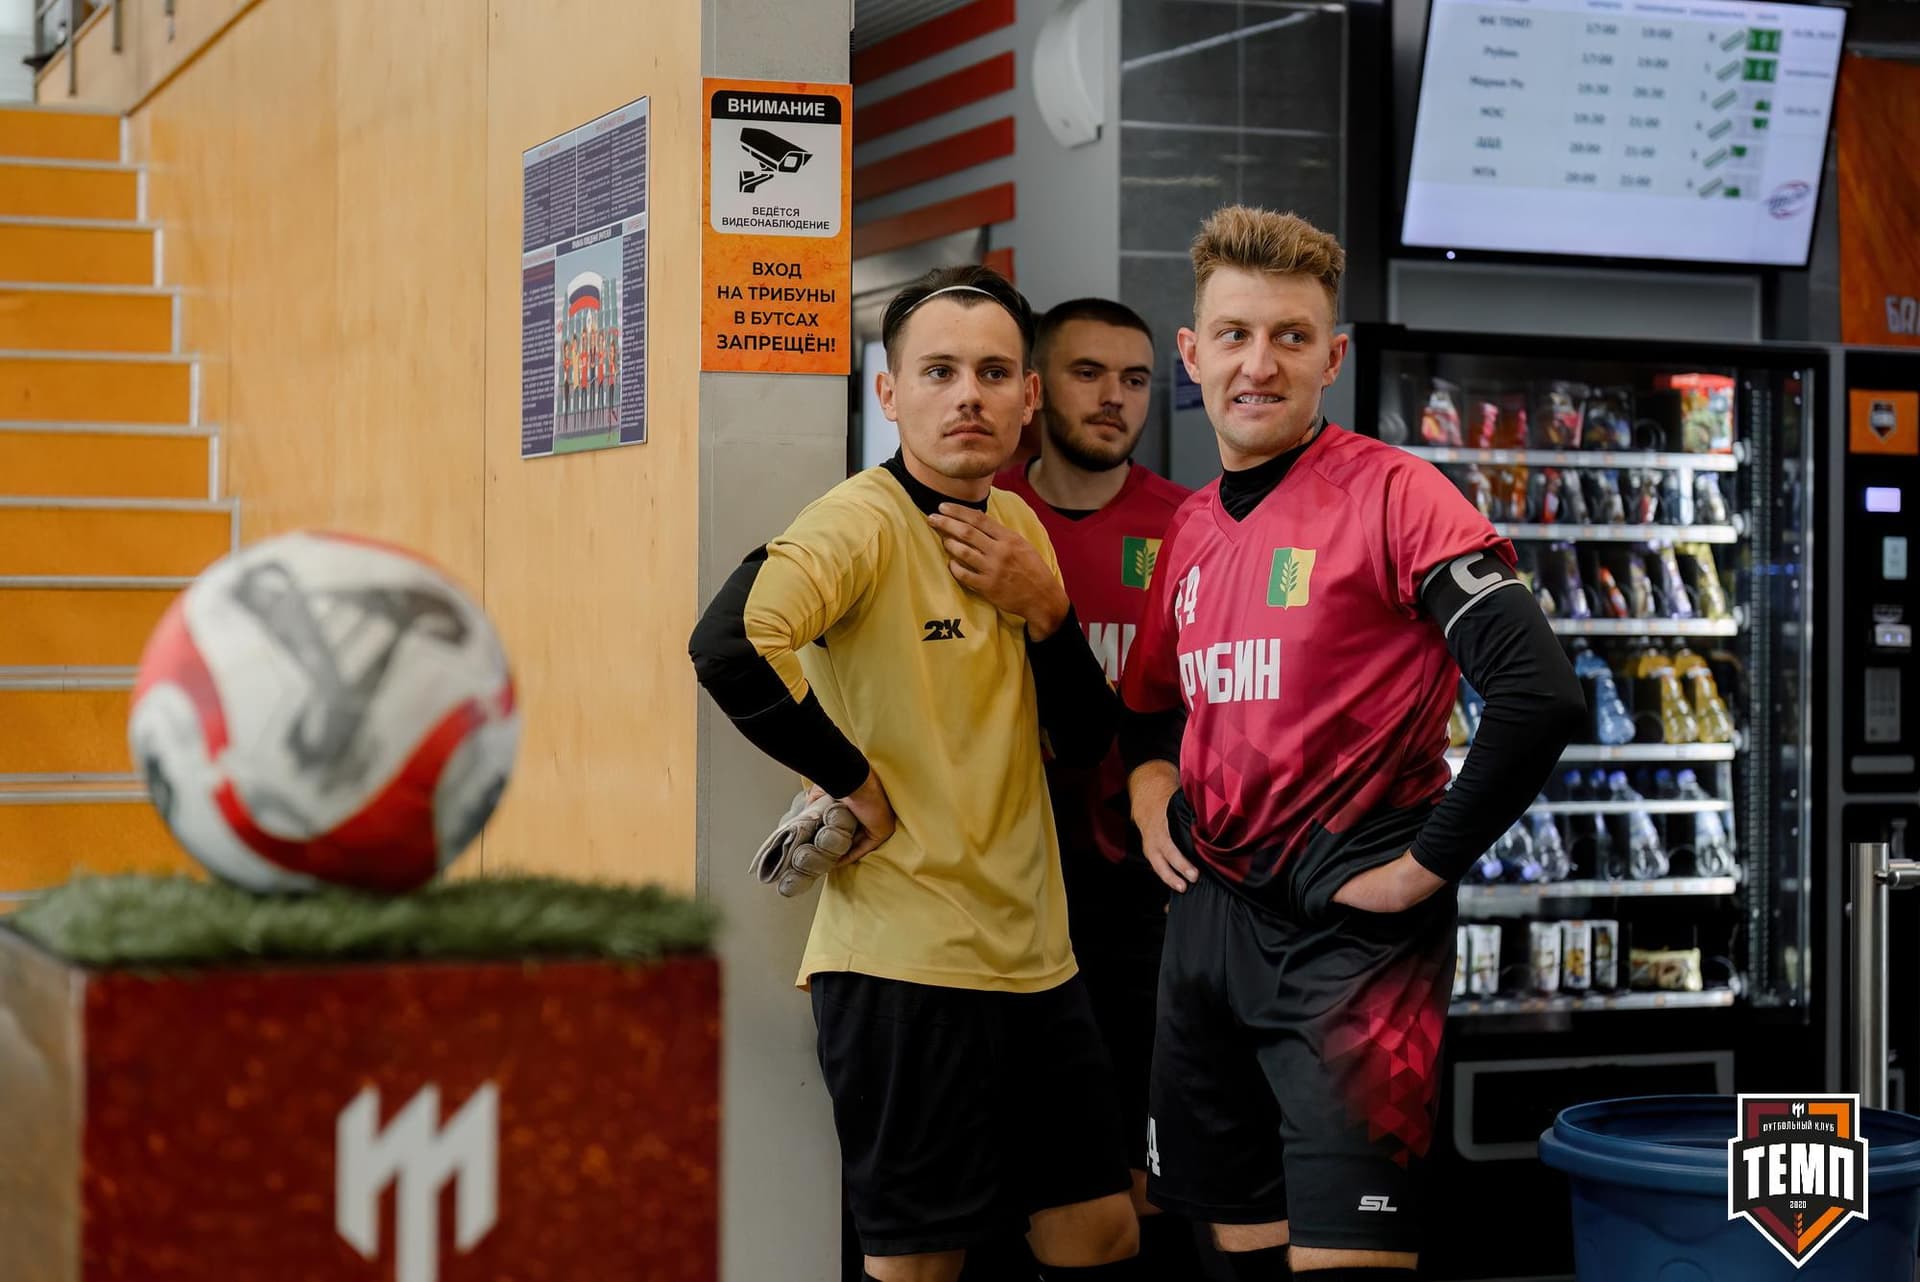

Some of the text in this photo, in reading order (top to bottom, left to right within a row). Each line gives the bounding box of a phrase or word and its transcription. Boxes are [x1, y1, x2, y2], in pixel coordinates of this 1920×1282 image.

[728, 98, 825, 117] ВНИМАНИЕ
[752, 205, 800, 217] ВЕДЁТСЯ
[722, 217, 830, 230] ВИДЕОНАБЛЮДЕНИЕ
[752, 262, 802, 280] ВХОД
[717, 285, 835, 303] НА ТРИБУНЫ
[734, 311, 819, 327] В БУТСАХ
[717, 334, 836, 353] ЗАПРЕЩЁН!
[922, 618, 966, 641] 2K
[1179, 638, 1281, 712] РУБИН
[1147, 1112, 1161, 1177] 4
[1358, 1195, 1398, 1212] SL
